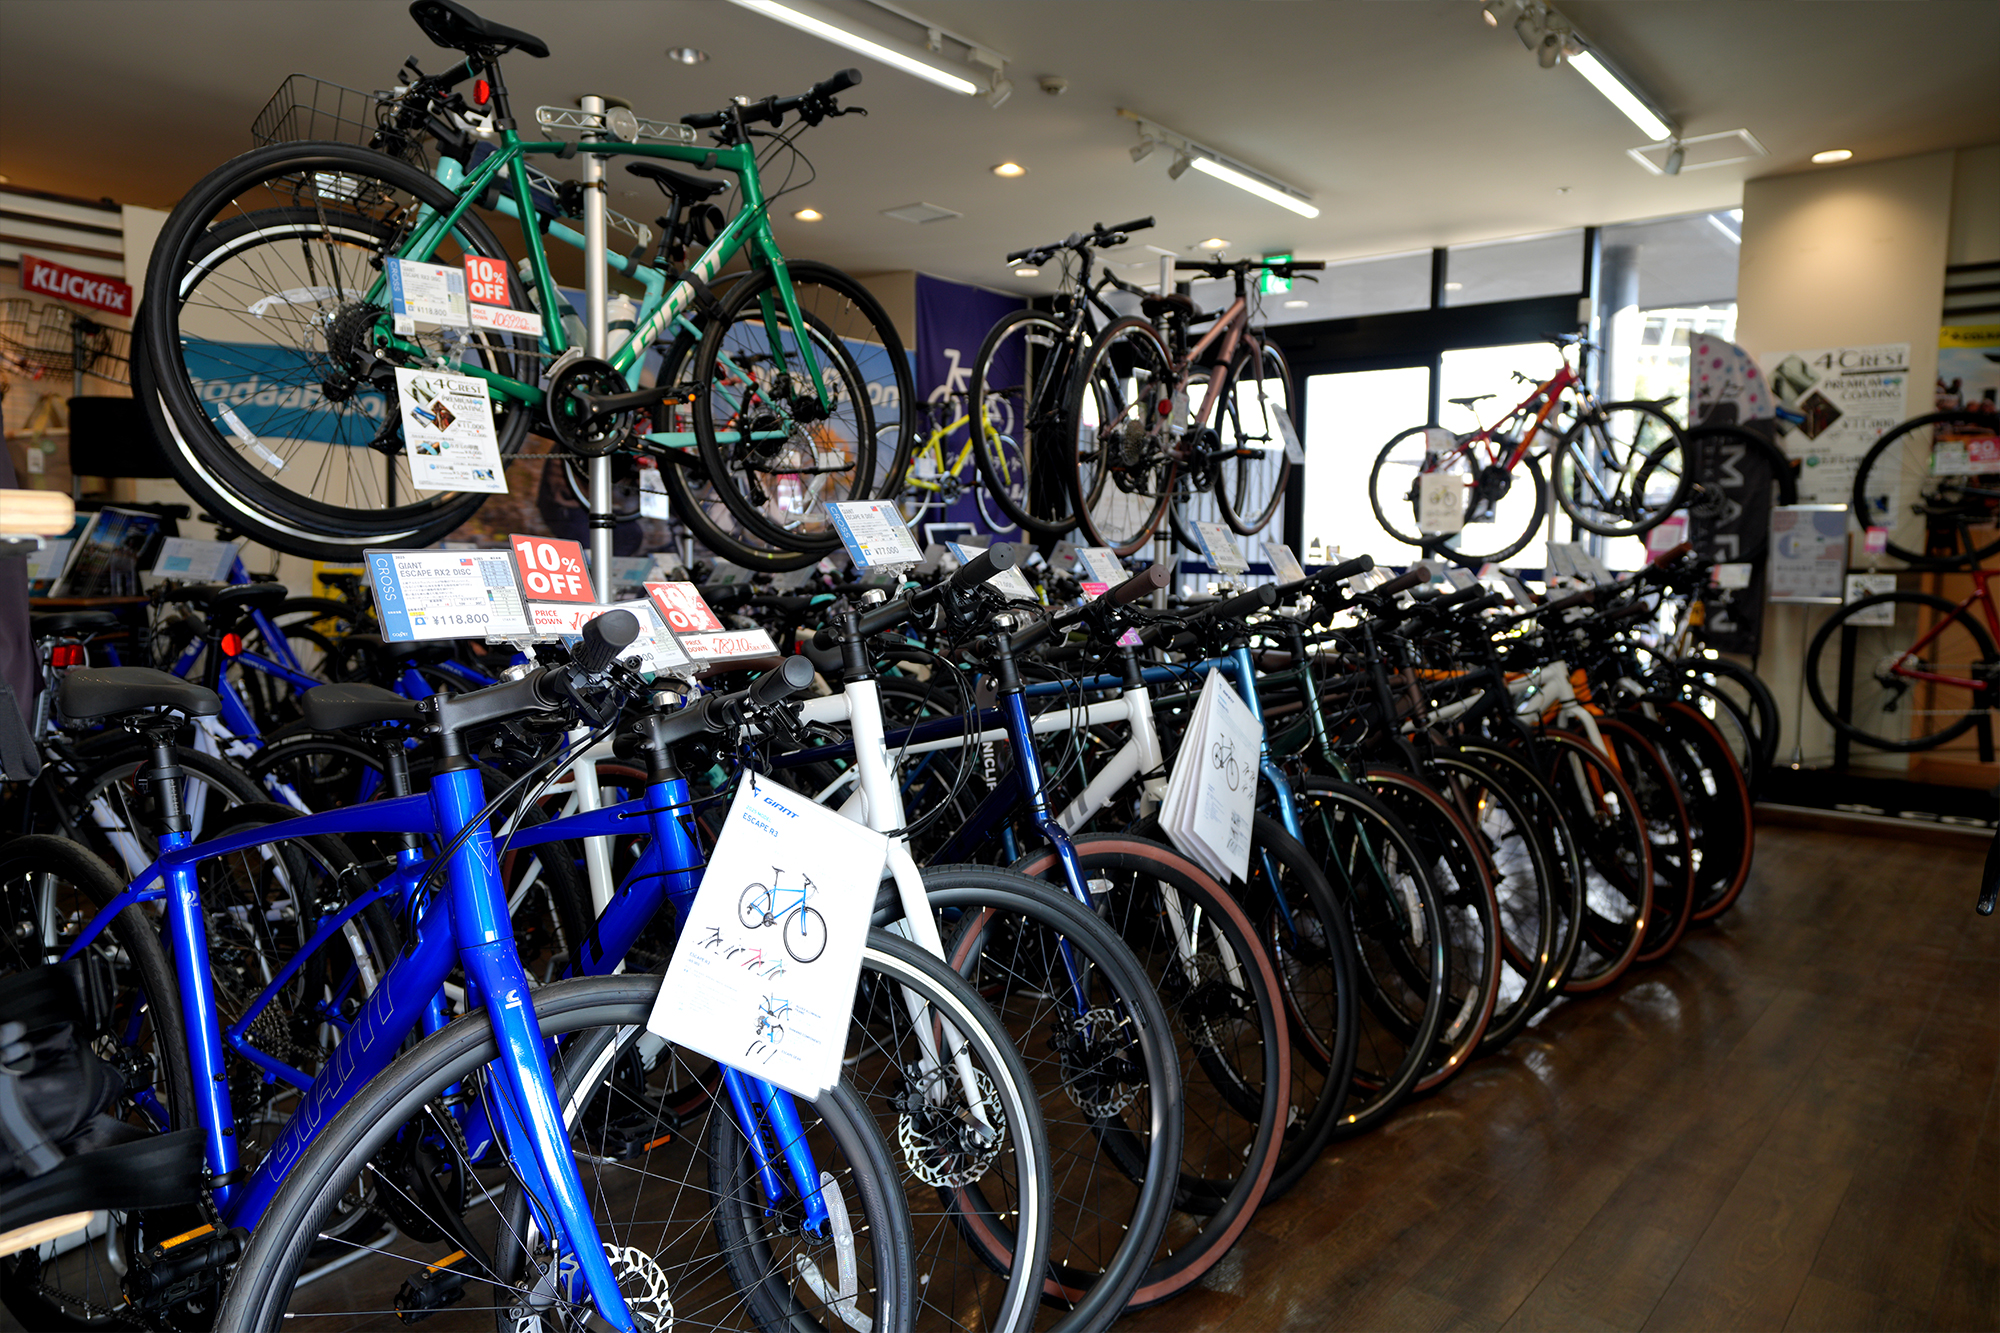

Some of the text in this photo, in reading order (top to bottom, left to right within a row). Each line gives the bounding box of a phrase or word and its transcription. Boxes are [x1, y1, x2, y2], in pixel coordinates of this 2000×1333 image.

[389, 260, 400, 292] CROSS
[467, 259, 504, 285] 10%
[31, 264, 126, 309] KLICKfix
[470, 282, 504, 300] OFF
[452, 403, 485, 412] COATING
[830, 506, 851, 539] CROSS
[1710, 443, 1747, 633] MARN
[398, 562, 422, 570] GIANT
[516, 541, 581, 574] 10%
[376, 557, 397, 601] CROSS
[400, 568, 472, 577] ESCAPE RX2 DISC
[527, 571, 582, 596] OFF
[764, 797, 800, 819] GIANT
[742, 812, 779, 838] ESCAPE R3
[268, 938, 409, 1183] GIANT
